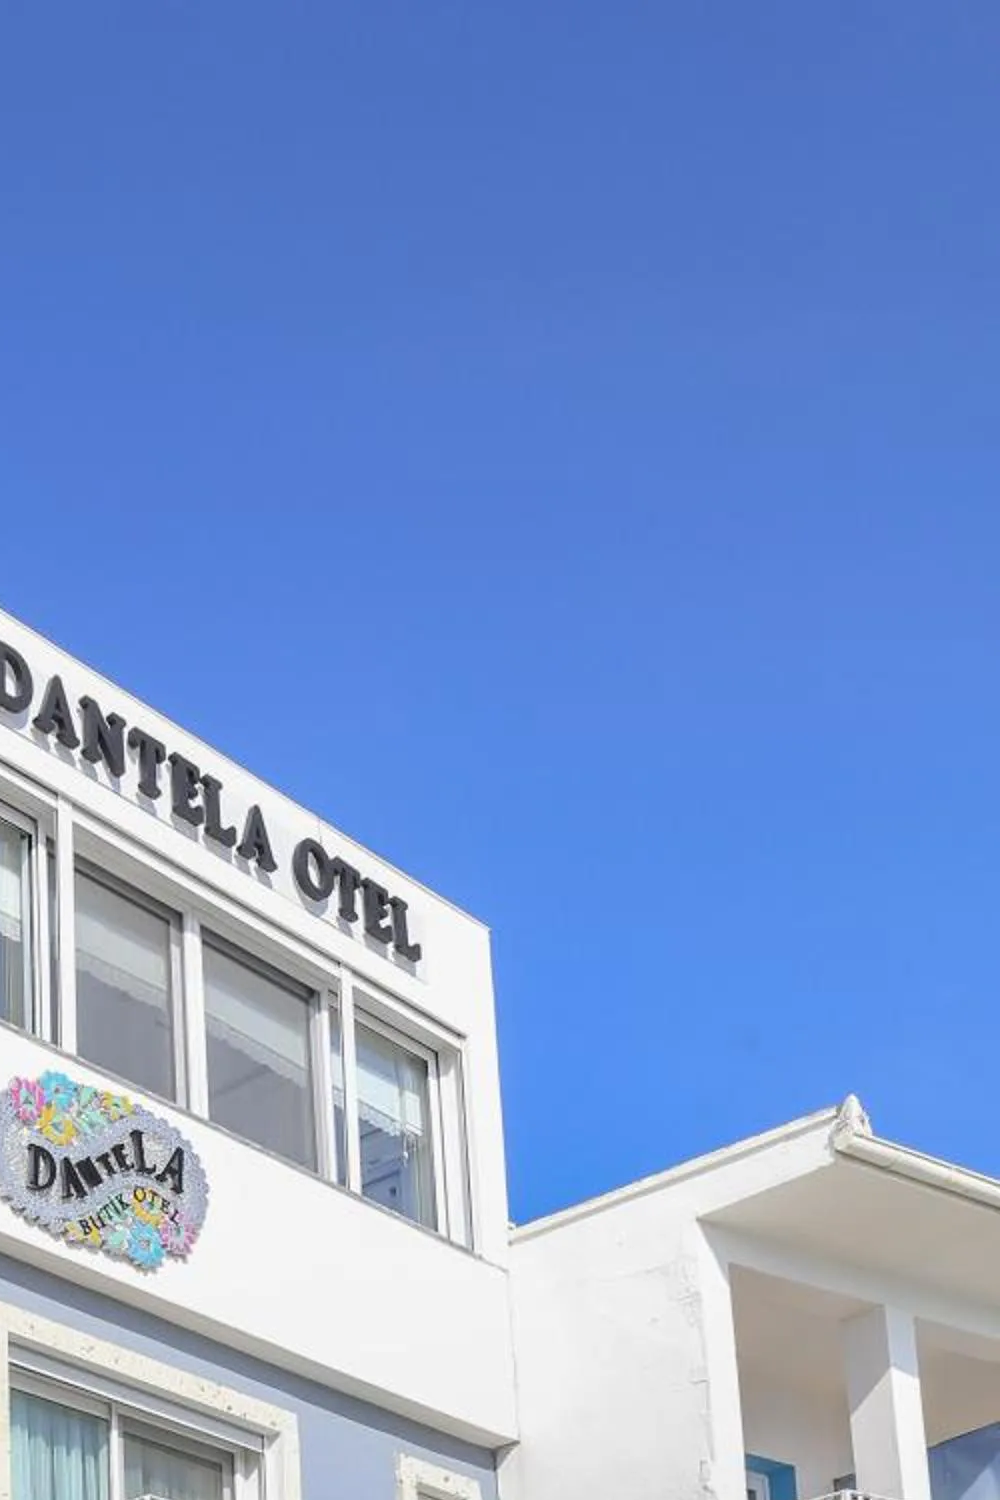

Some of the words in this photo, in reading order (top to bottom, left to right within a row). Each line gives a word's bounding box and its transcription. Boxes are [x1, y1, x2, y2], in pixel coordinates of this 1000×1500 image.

[292, 836, 422, 962] OTEL
[25, 1129, 185, 1200] DANTELA
[133, 1186, 180, 1226] OTEL
